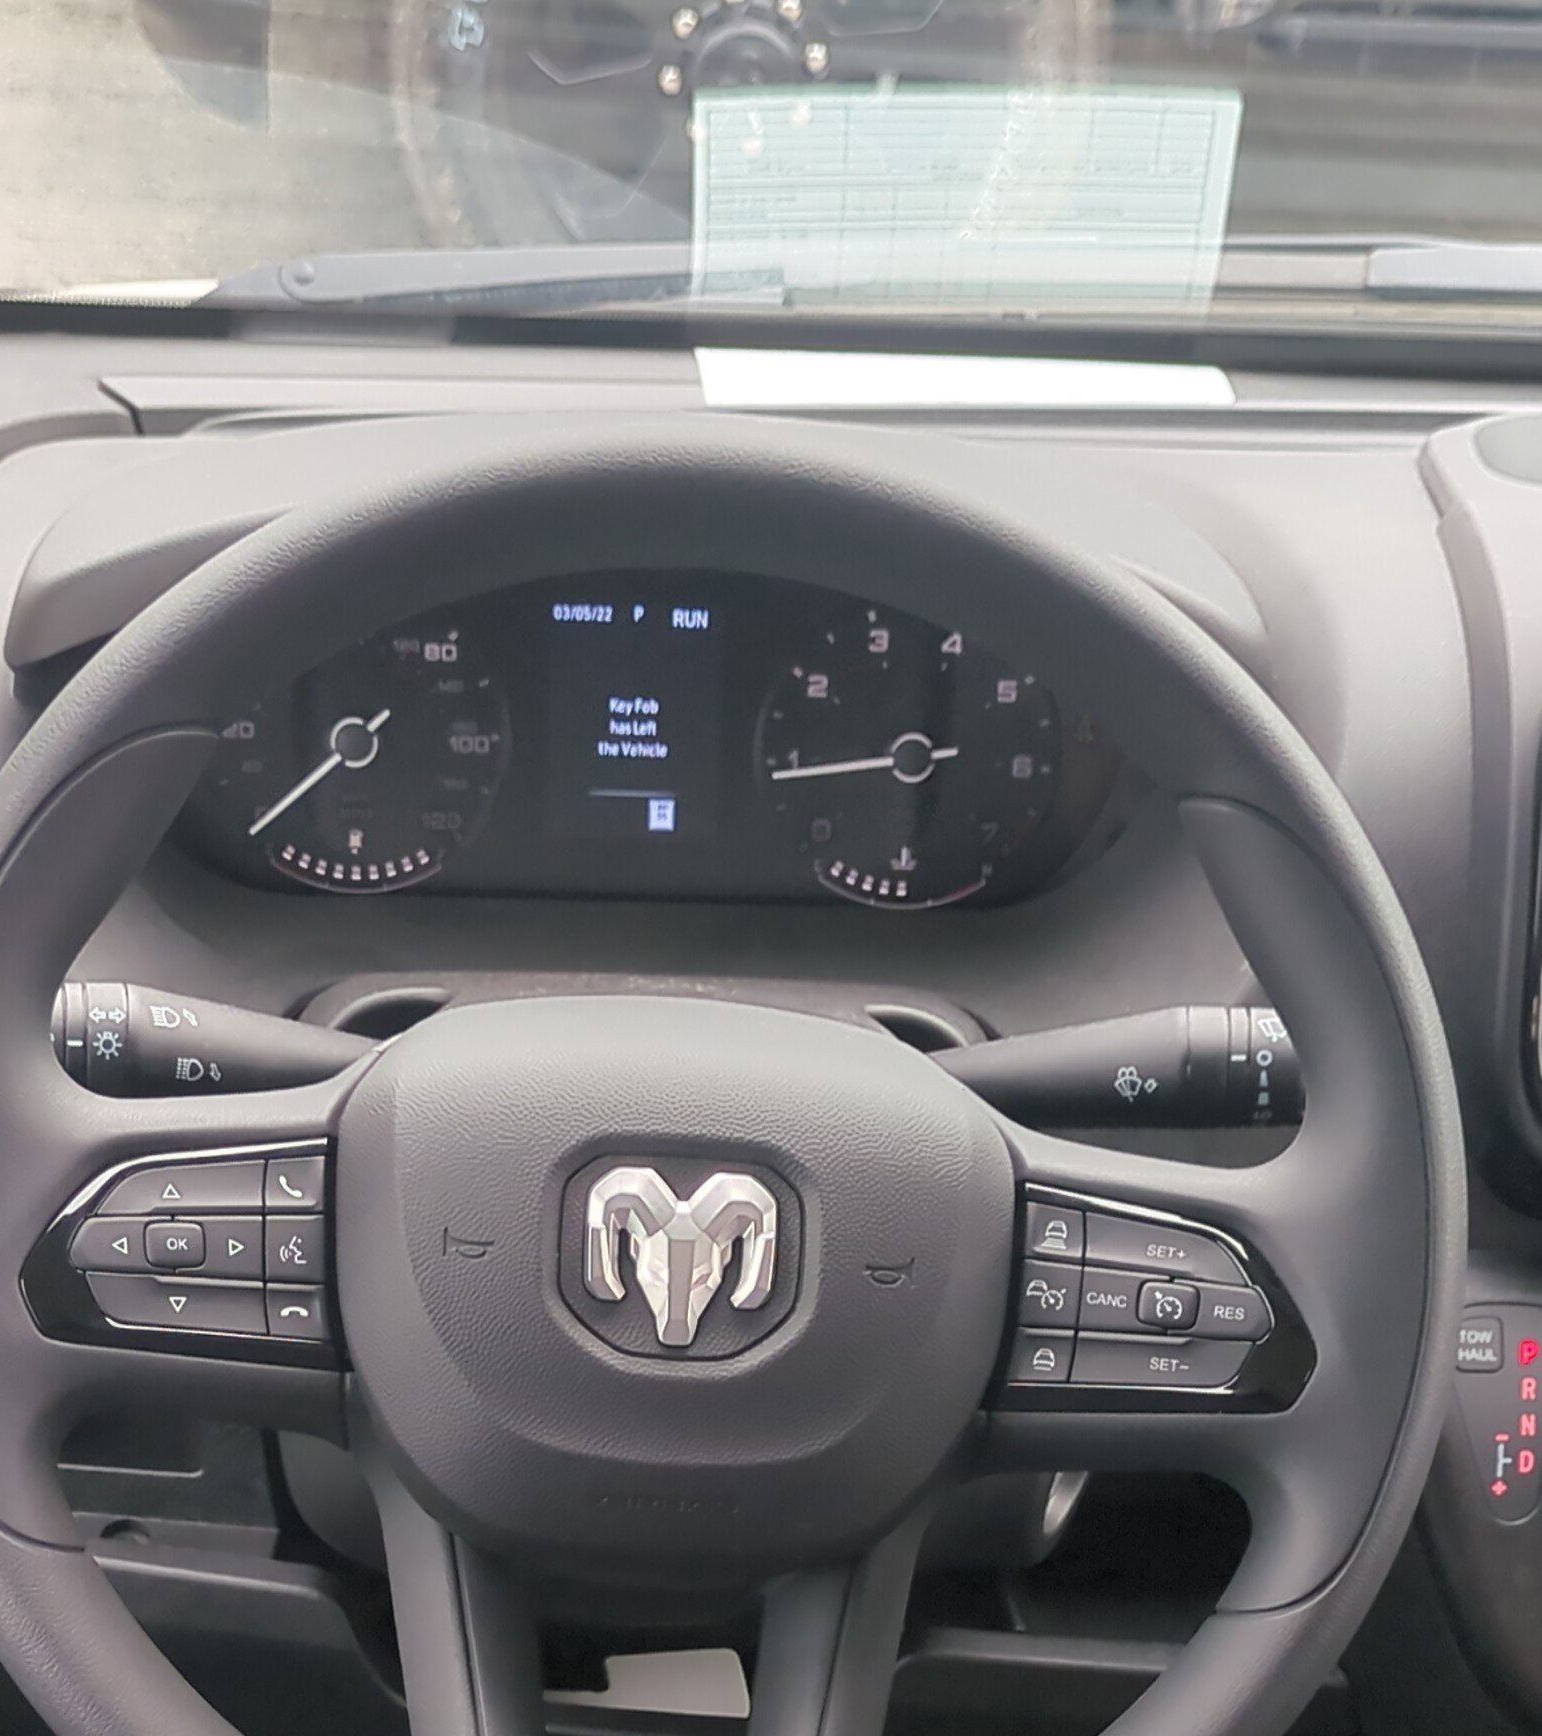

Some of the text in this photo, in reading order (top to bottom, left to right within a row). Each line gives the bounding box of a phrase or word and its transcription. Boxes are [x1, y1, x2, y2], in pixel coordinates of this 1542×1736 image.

[552, 603, 709, 629] 03/05/22 P RUN
[869, 628, 890, 653] 3
[941, 632, 963, 655] 4
[424, 642, 458, 662] 80
[807, 674, 829, 698] 2
[997, 679, 1018, 703] 5
[609, 697, 659, 717] Key Fob
[609, 719, 657, 737] has Left
[449, 735, 490, 754] 100
[597, 741, 669, 758] the Vehicle
[166, 1237, 188, 1250] OK
[1146, 1243, 1187, 1259] SET+
[1086, 1291, 1127, 1309] CANC
[1213, 1304, 1245, 1321] RES
[1459, 1328, 1493, 1344] TOW
[1457, 1347, 1498, 1362] HAUL
[1519, 1338, 1541, 1366] P
[1520, 1376, 1538, 1401] R
[1520, 1412, 1537, 1437] N
[1517, 1450, 1535, 1474] D
